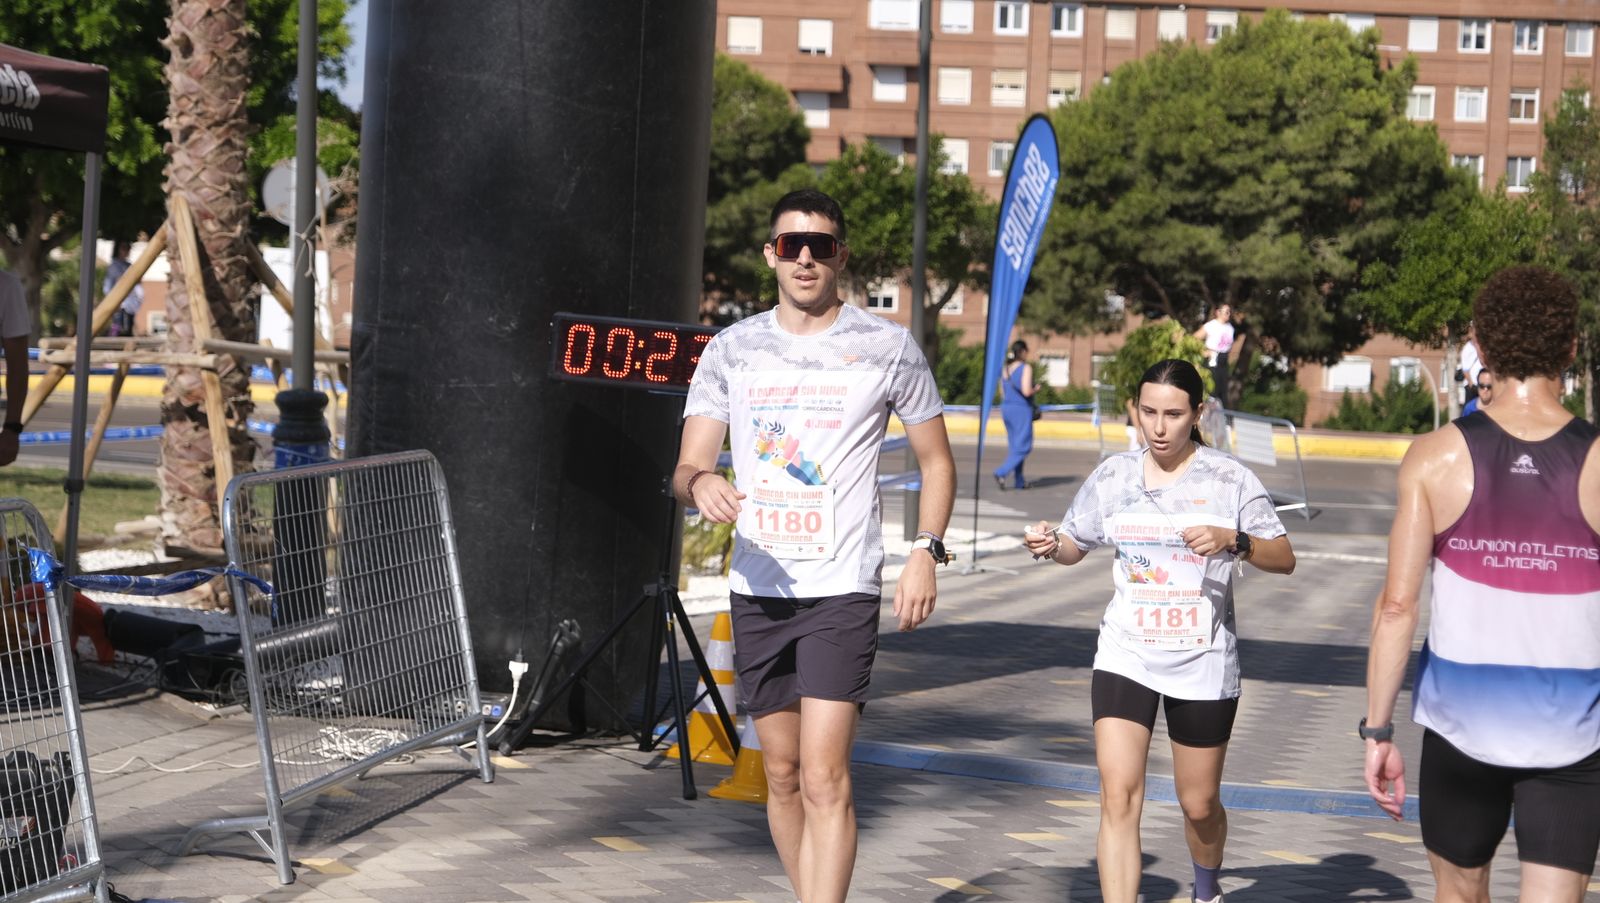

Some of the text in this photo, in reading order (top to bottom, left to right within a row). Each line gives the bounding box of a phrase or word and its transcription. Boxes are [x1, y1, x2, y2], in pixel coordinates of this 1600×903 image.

[801, 385, 817, 396] SIN
[819, 385, 847, 396] HUMO
[755, 508, 822, 533] 1180
[1520, 542, 1599, 560] ATLETAS
[1483, 555, 1557, 571] ALMERÍA
[1133, 607, 1198, 627] 1181
